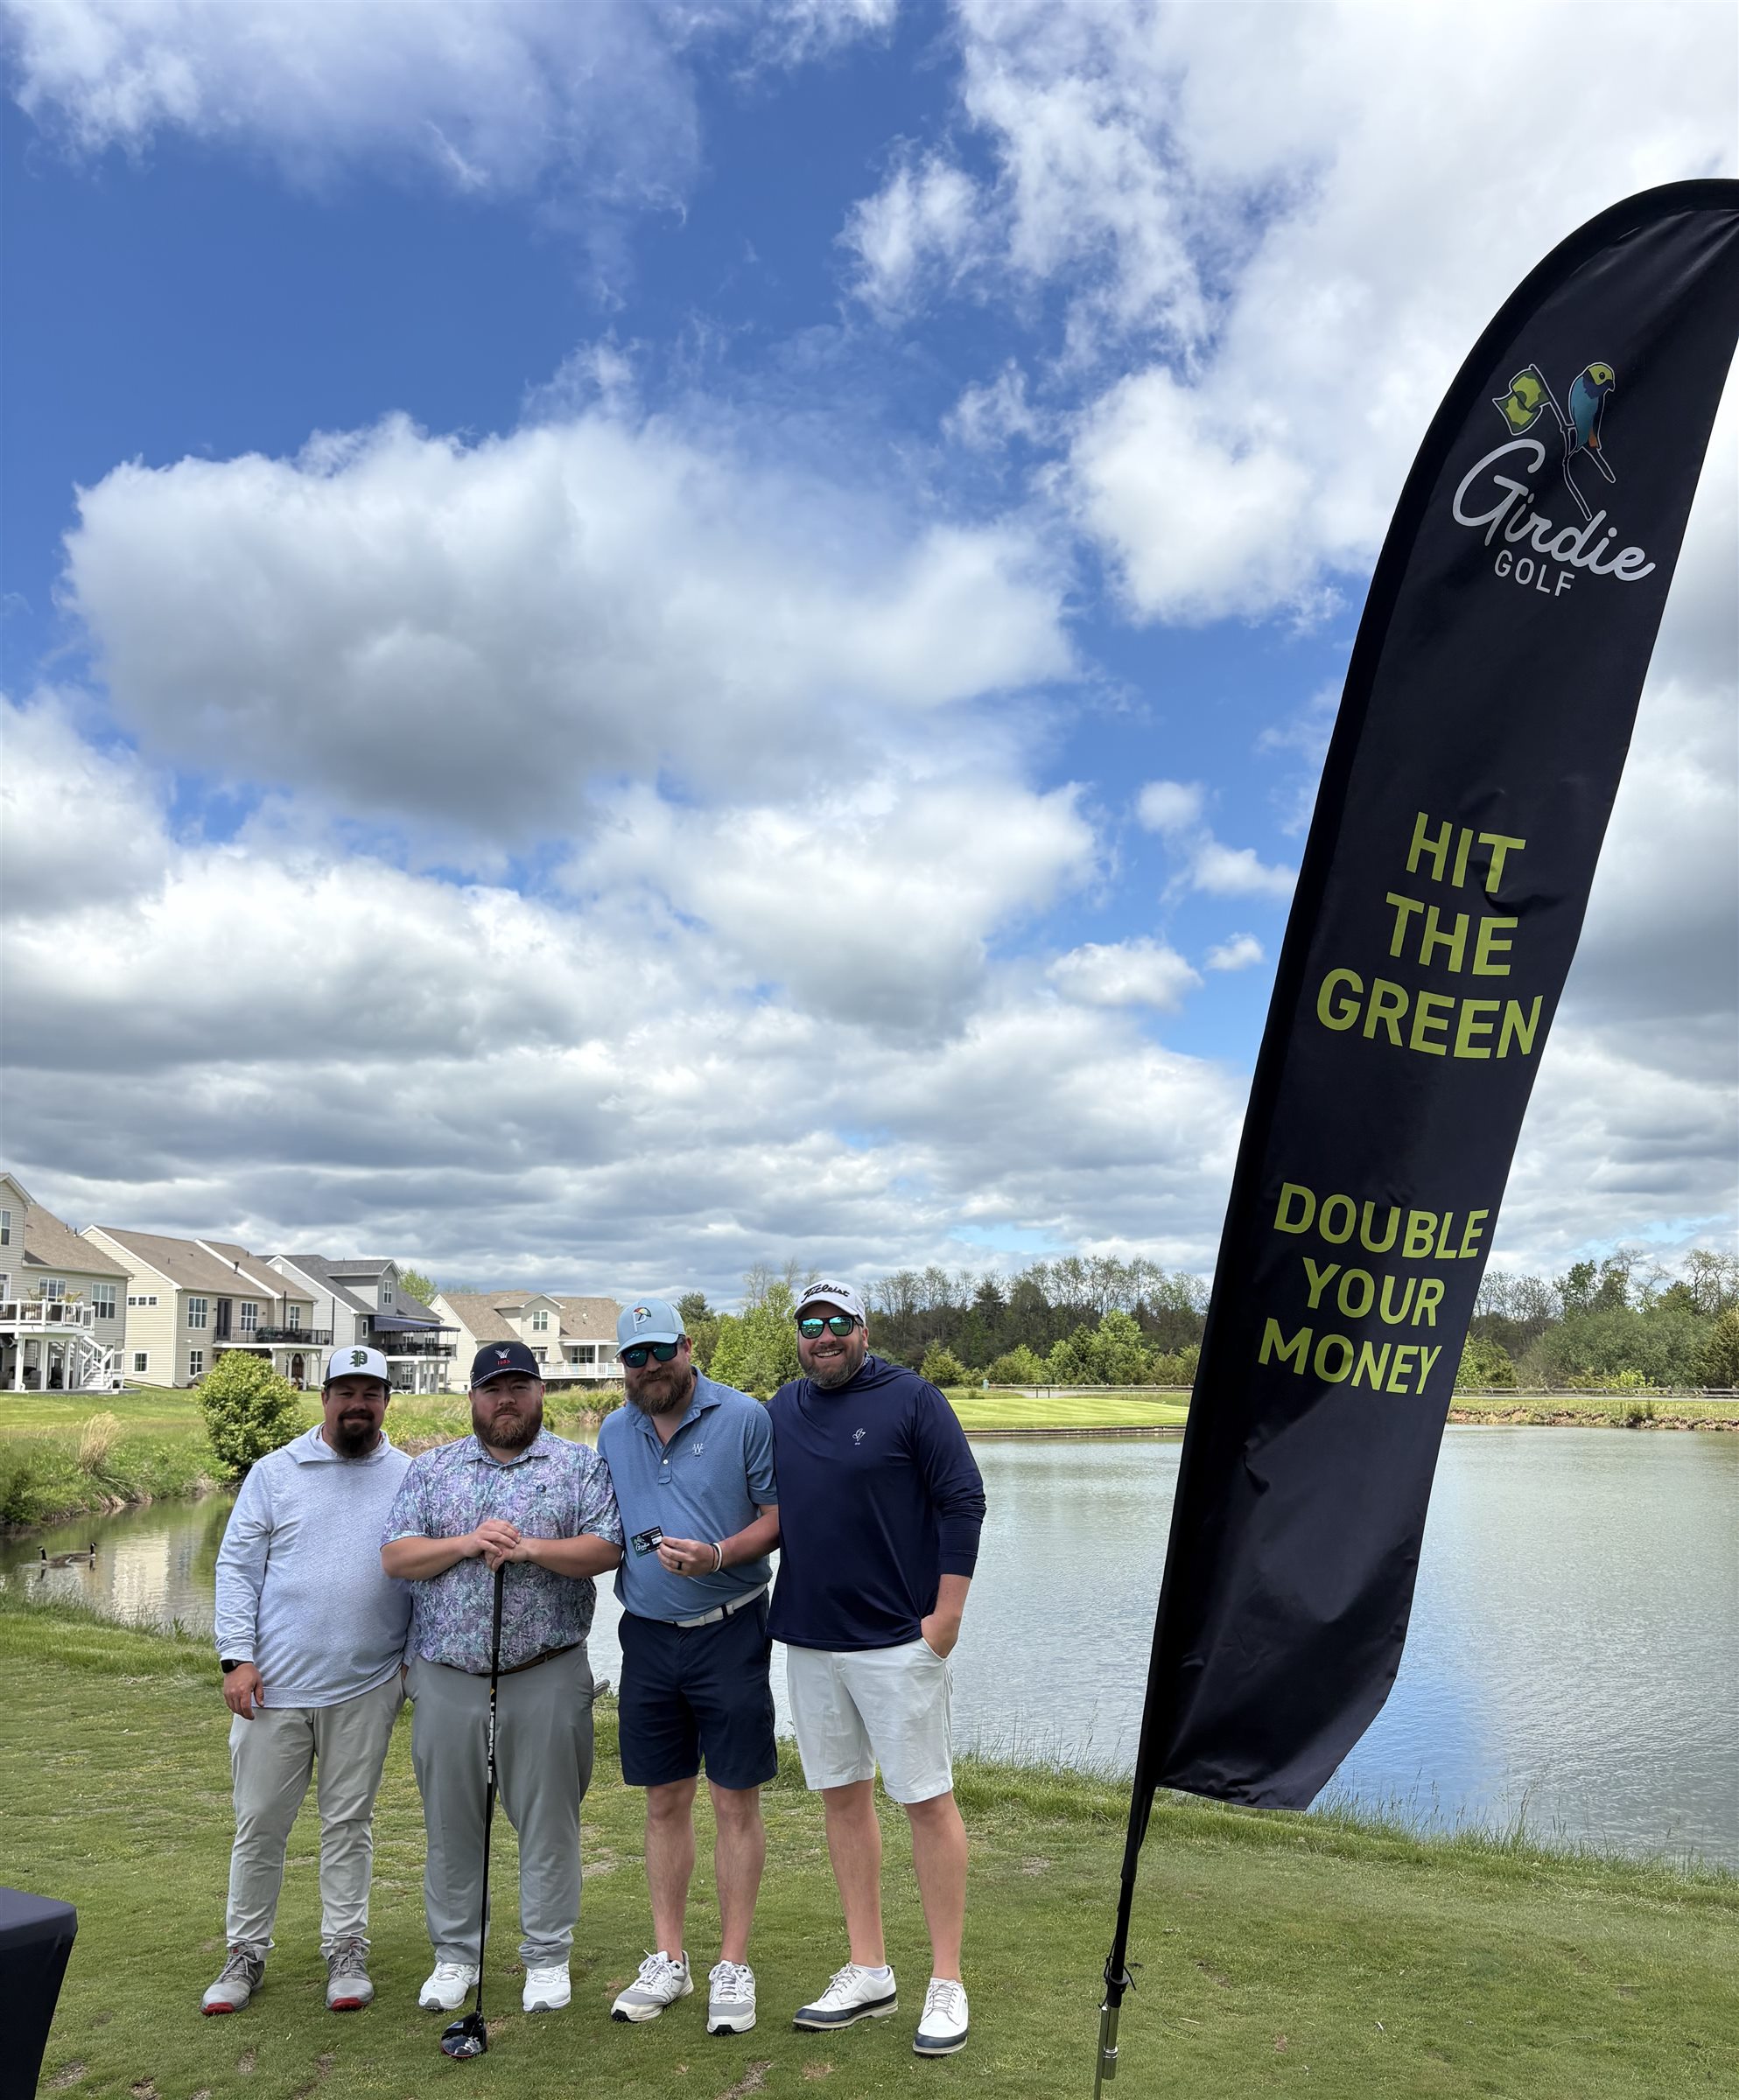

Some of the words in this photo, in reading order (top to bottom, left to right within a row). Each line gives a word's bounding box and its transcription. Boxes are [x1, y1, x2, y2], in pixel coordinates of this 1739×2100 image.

[1453, 439, 1656, 581] Girdie
[1494, 550, 1575, 597] GOLF
[1406, 811, 1526, 893] HIT
[1385, 892, 1518, 976] THE
[1316, 968, 1544, 1059] GREEN
[1273, 1181, 1490, 1259] DOUBLE
[801, 1284, 851, 1304] Titleist
[1302, 1256, 1445, 1326] YOUR
[349, 1349, 368, 1368] P
[1258, 1317, 1443, 1395] MONEY
